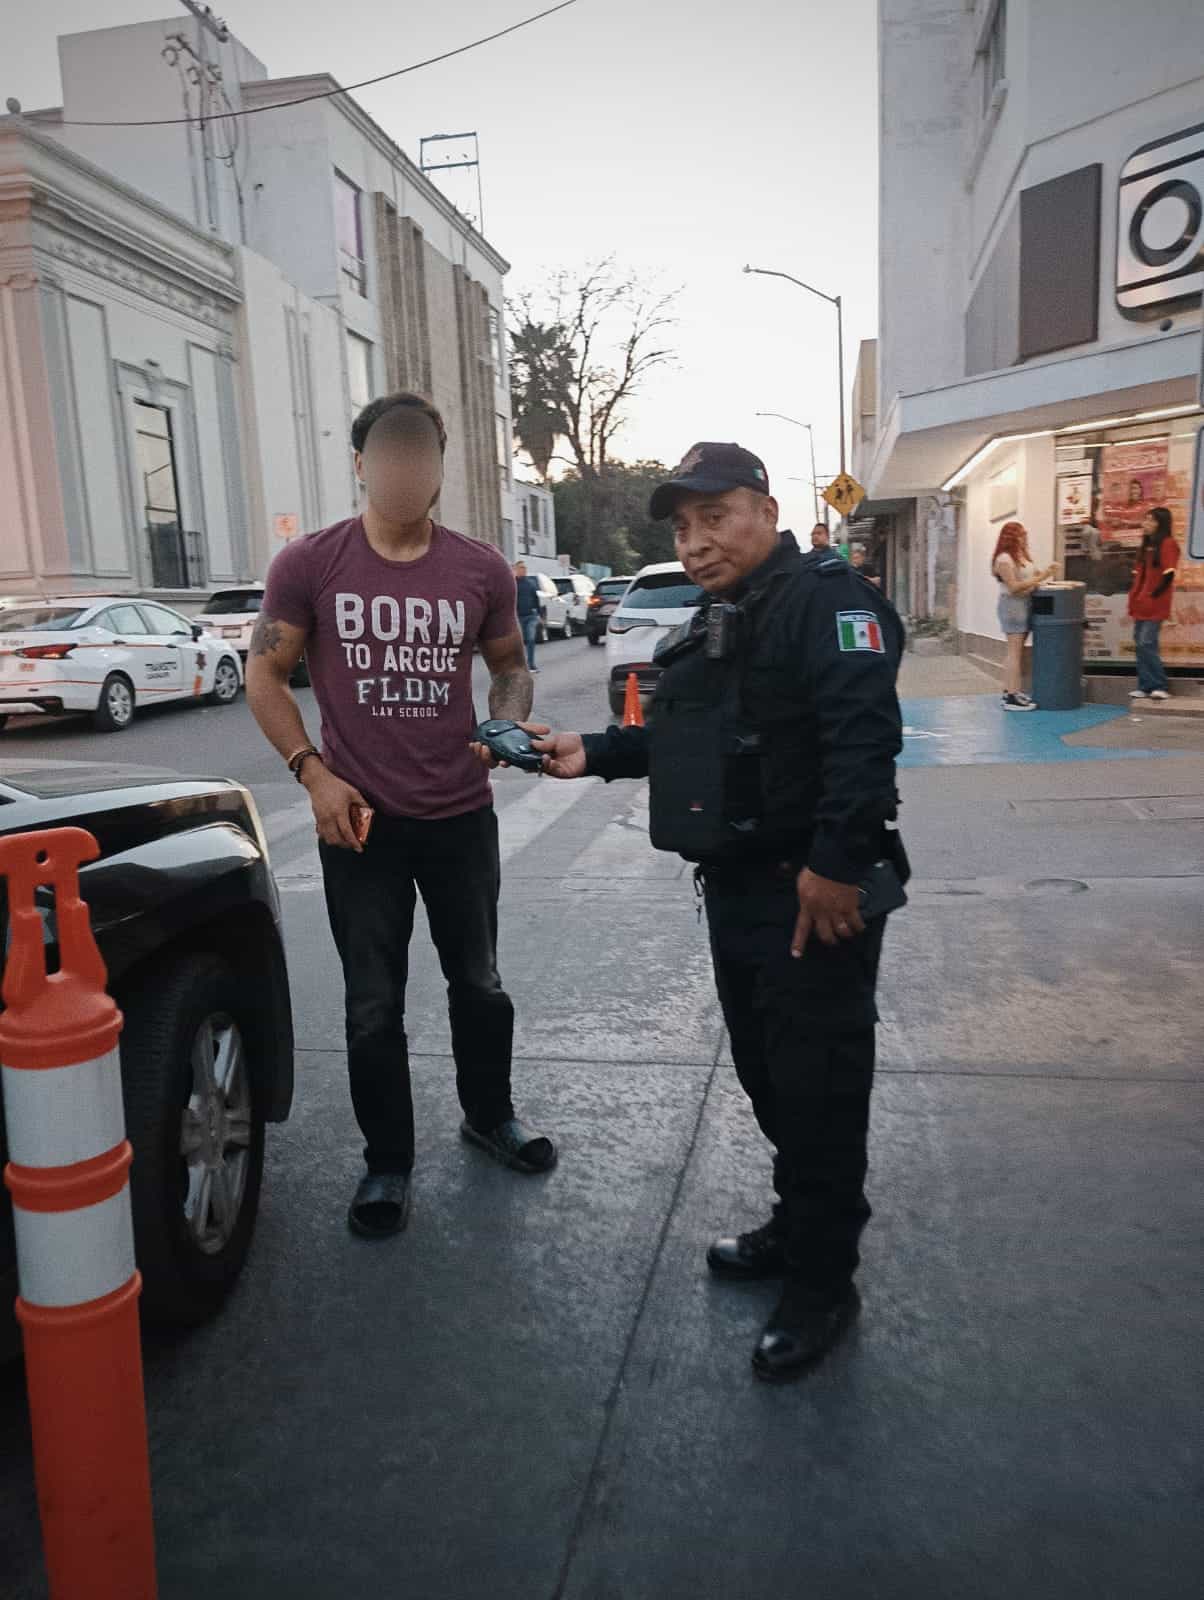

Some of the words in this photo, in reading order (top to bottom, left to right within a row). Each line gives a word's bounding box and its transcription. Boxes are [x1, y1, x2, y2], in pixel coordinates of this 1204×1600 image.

[335, 593, 465, 645] BORN
[341, 643, 371, 669] TO
[383, 645, 460, 672] ARGUE
[356, 677, 450, 705] FLDM
[371, 706, 393, 717] LAW
[399, 707, 439, 718] SCHOOL
